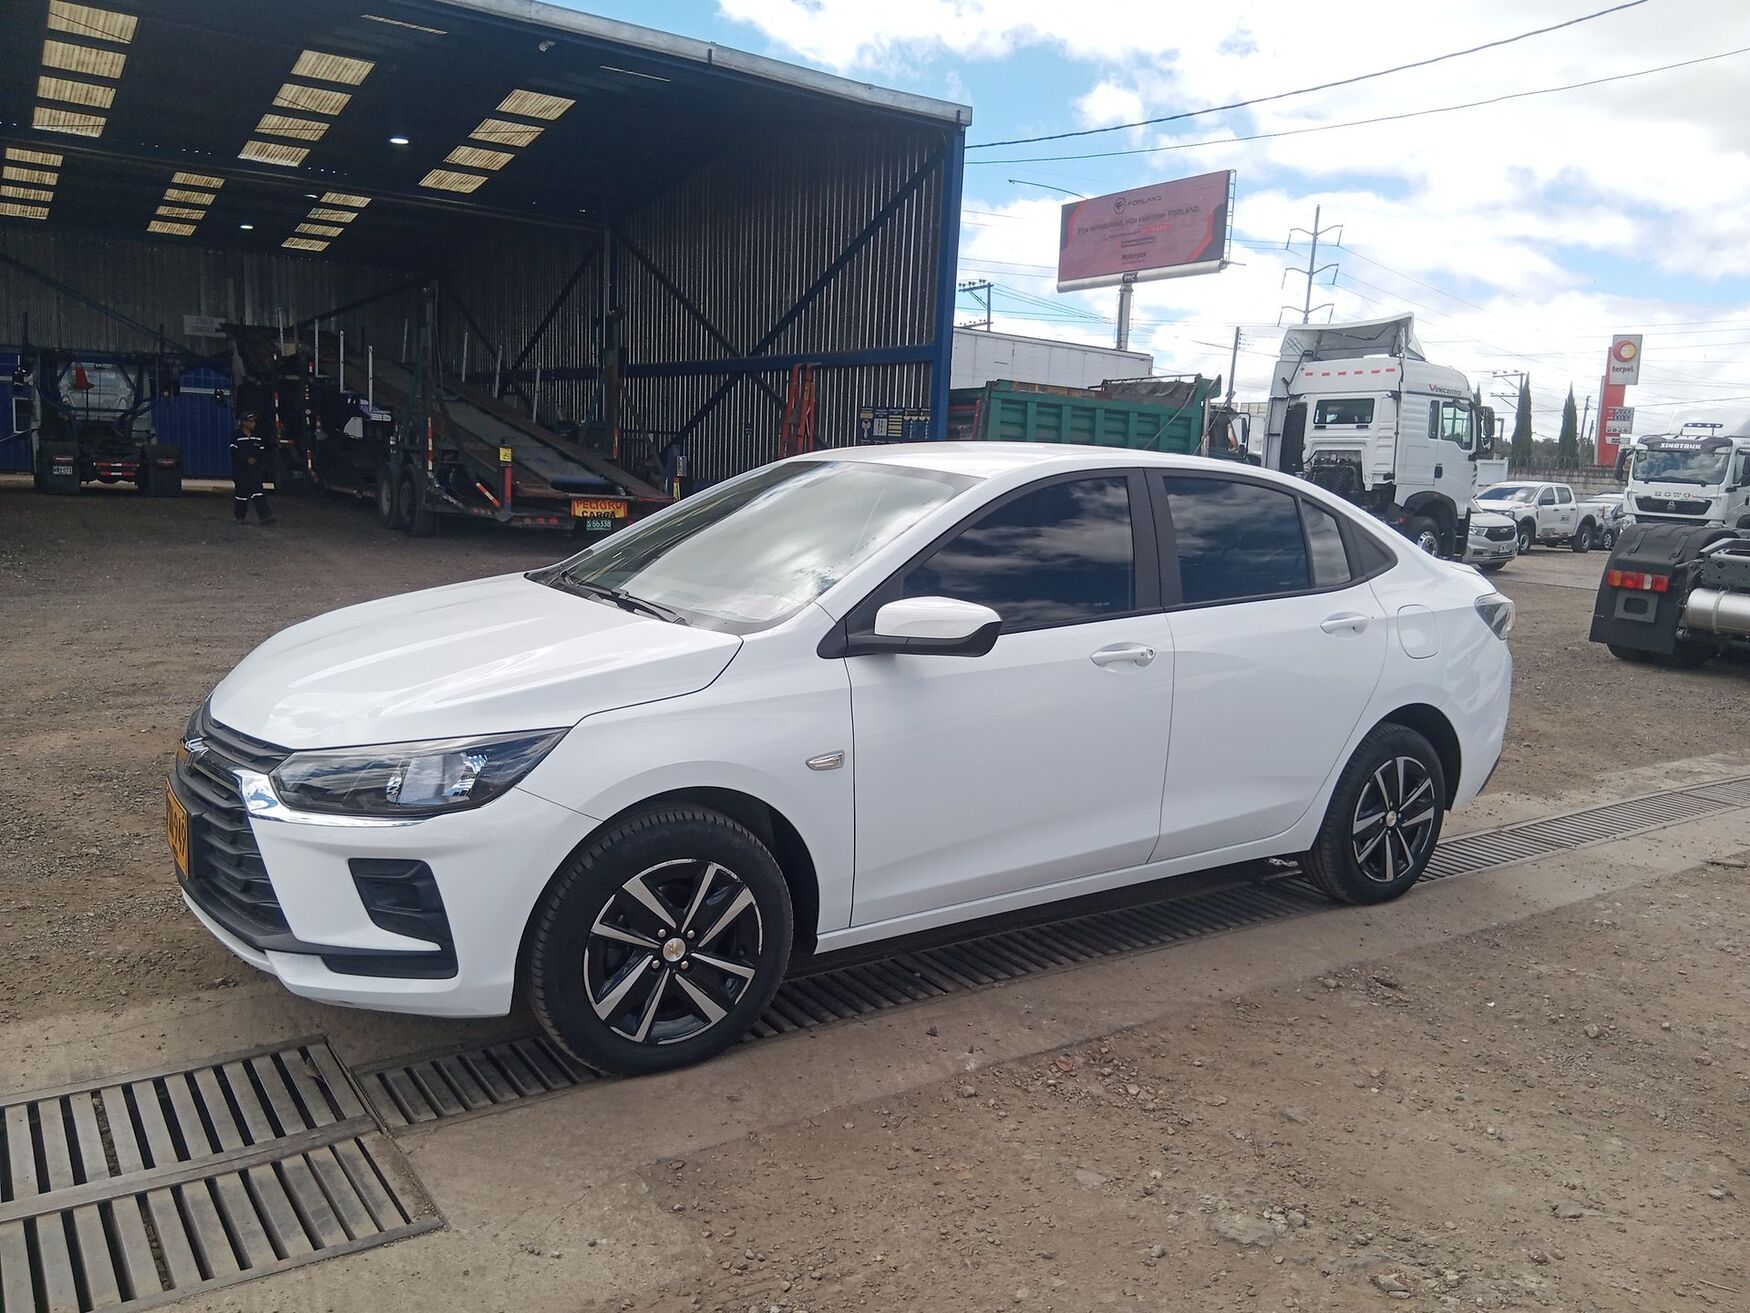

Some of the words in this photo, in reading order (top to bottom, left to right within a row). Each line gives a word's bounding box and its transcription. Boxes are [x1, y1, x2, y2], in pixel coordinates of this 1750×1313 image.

[1612, 365, 1634, 374] terpel
[1660, 442, 1702, 450] SINOTRUK
[575, 500, 622, 509] PELIGRO
[581, 511, 617, 519] CARGA
